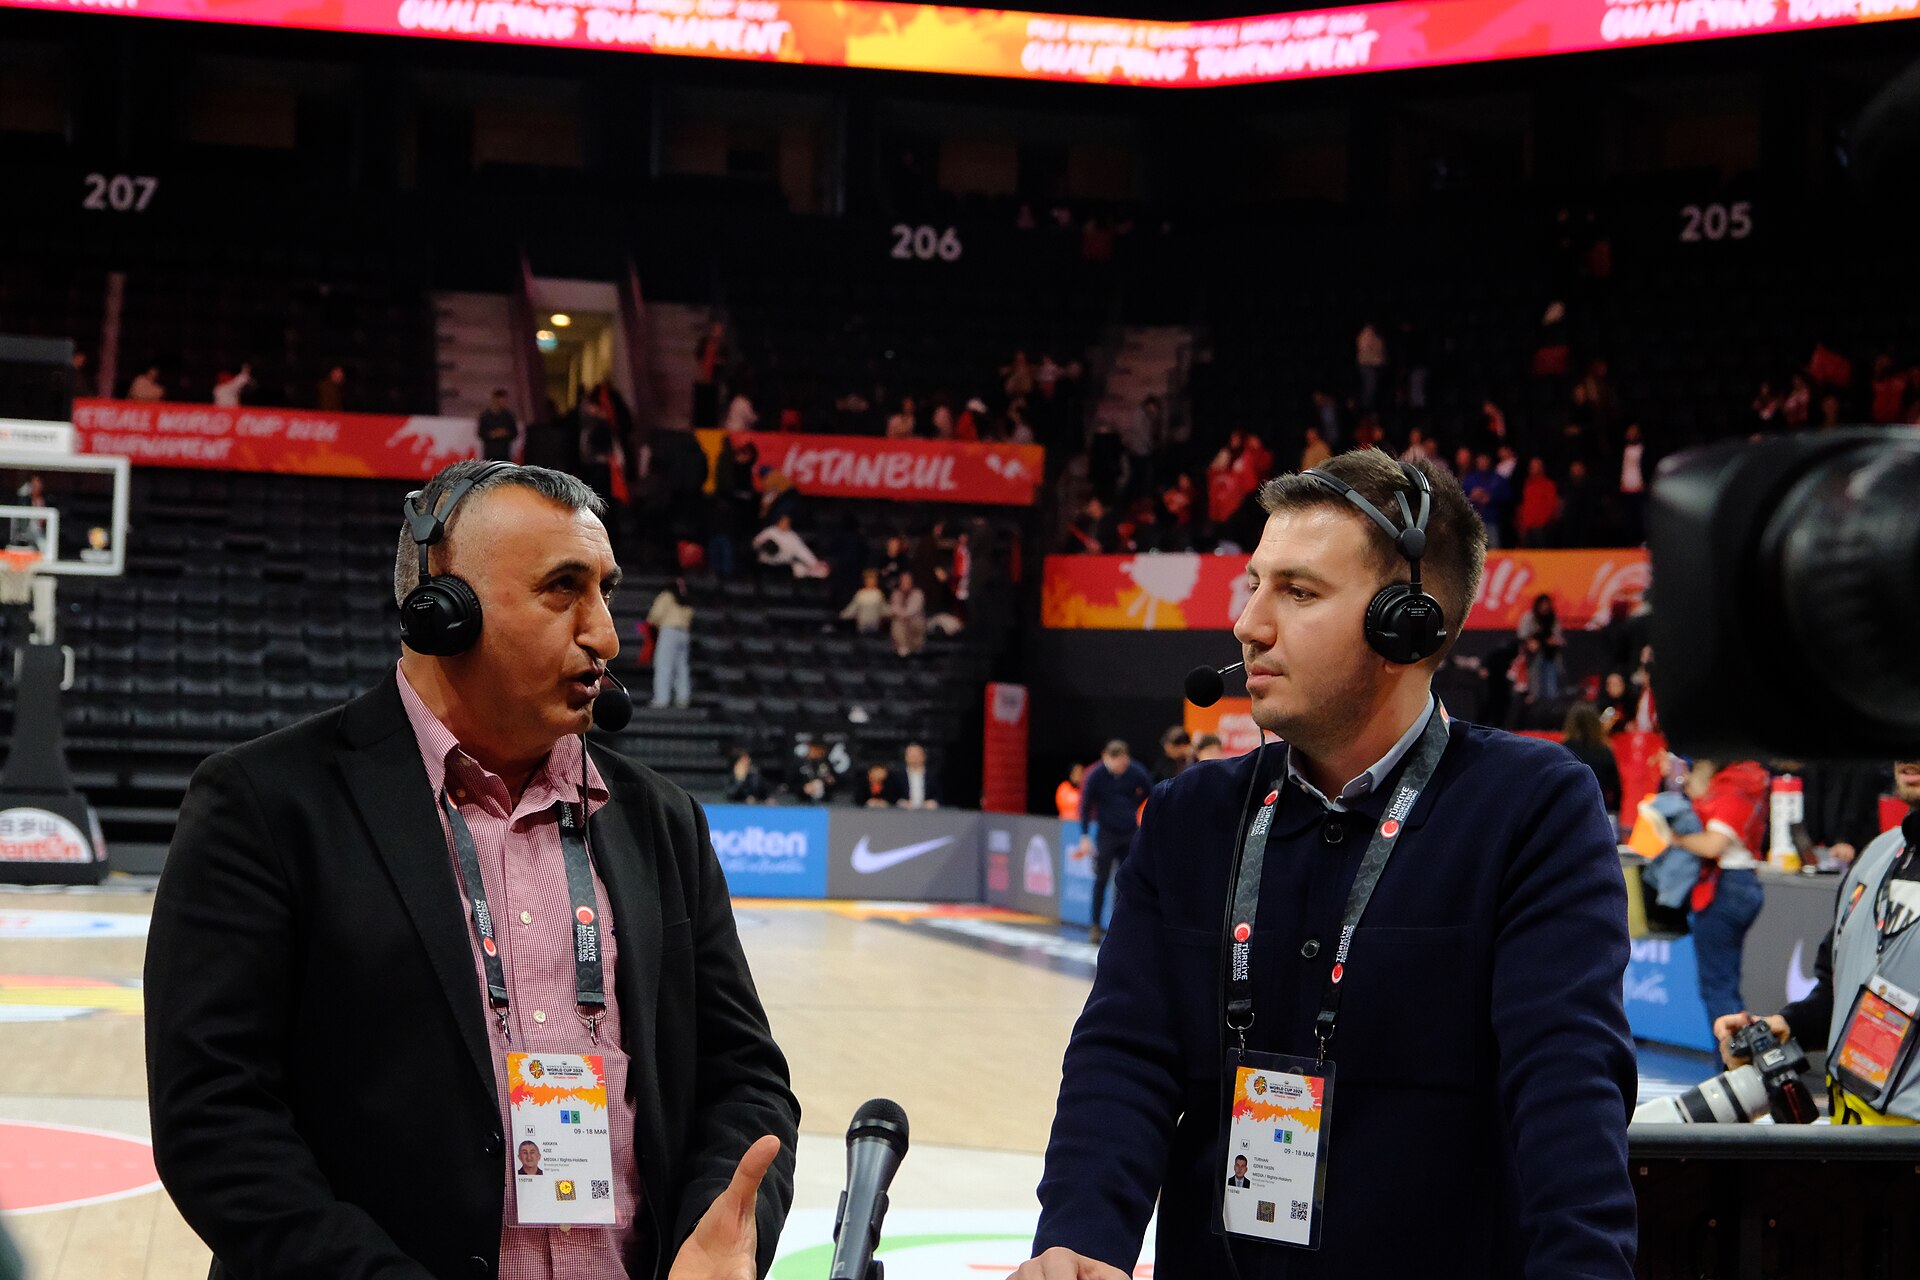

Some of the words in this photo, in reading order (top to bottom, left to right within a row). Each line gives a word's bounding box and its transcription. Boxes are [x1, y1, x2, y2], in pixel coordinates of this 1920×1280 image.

[84, 174, 158, 212] 207
[1680, 203, 1753, 242] 205
[891, 225, 961, 262] 206
[1388, 786, 1410, 819] TÜRKİYE
[587, 925, 598, 962] TÜRKİYE
[1241, 942, 1250, 981] TÜRKİYE
